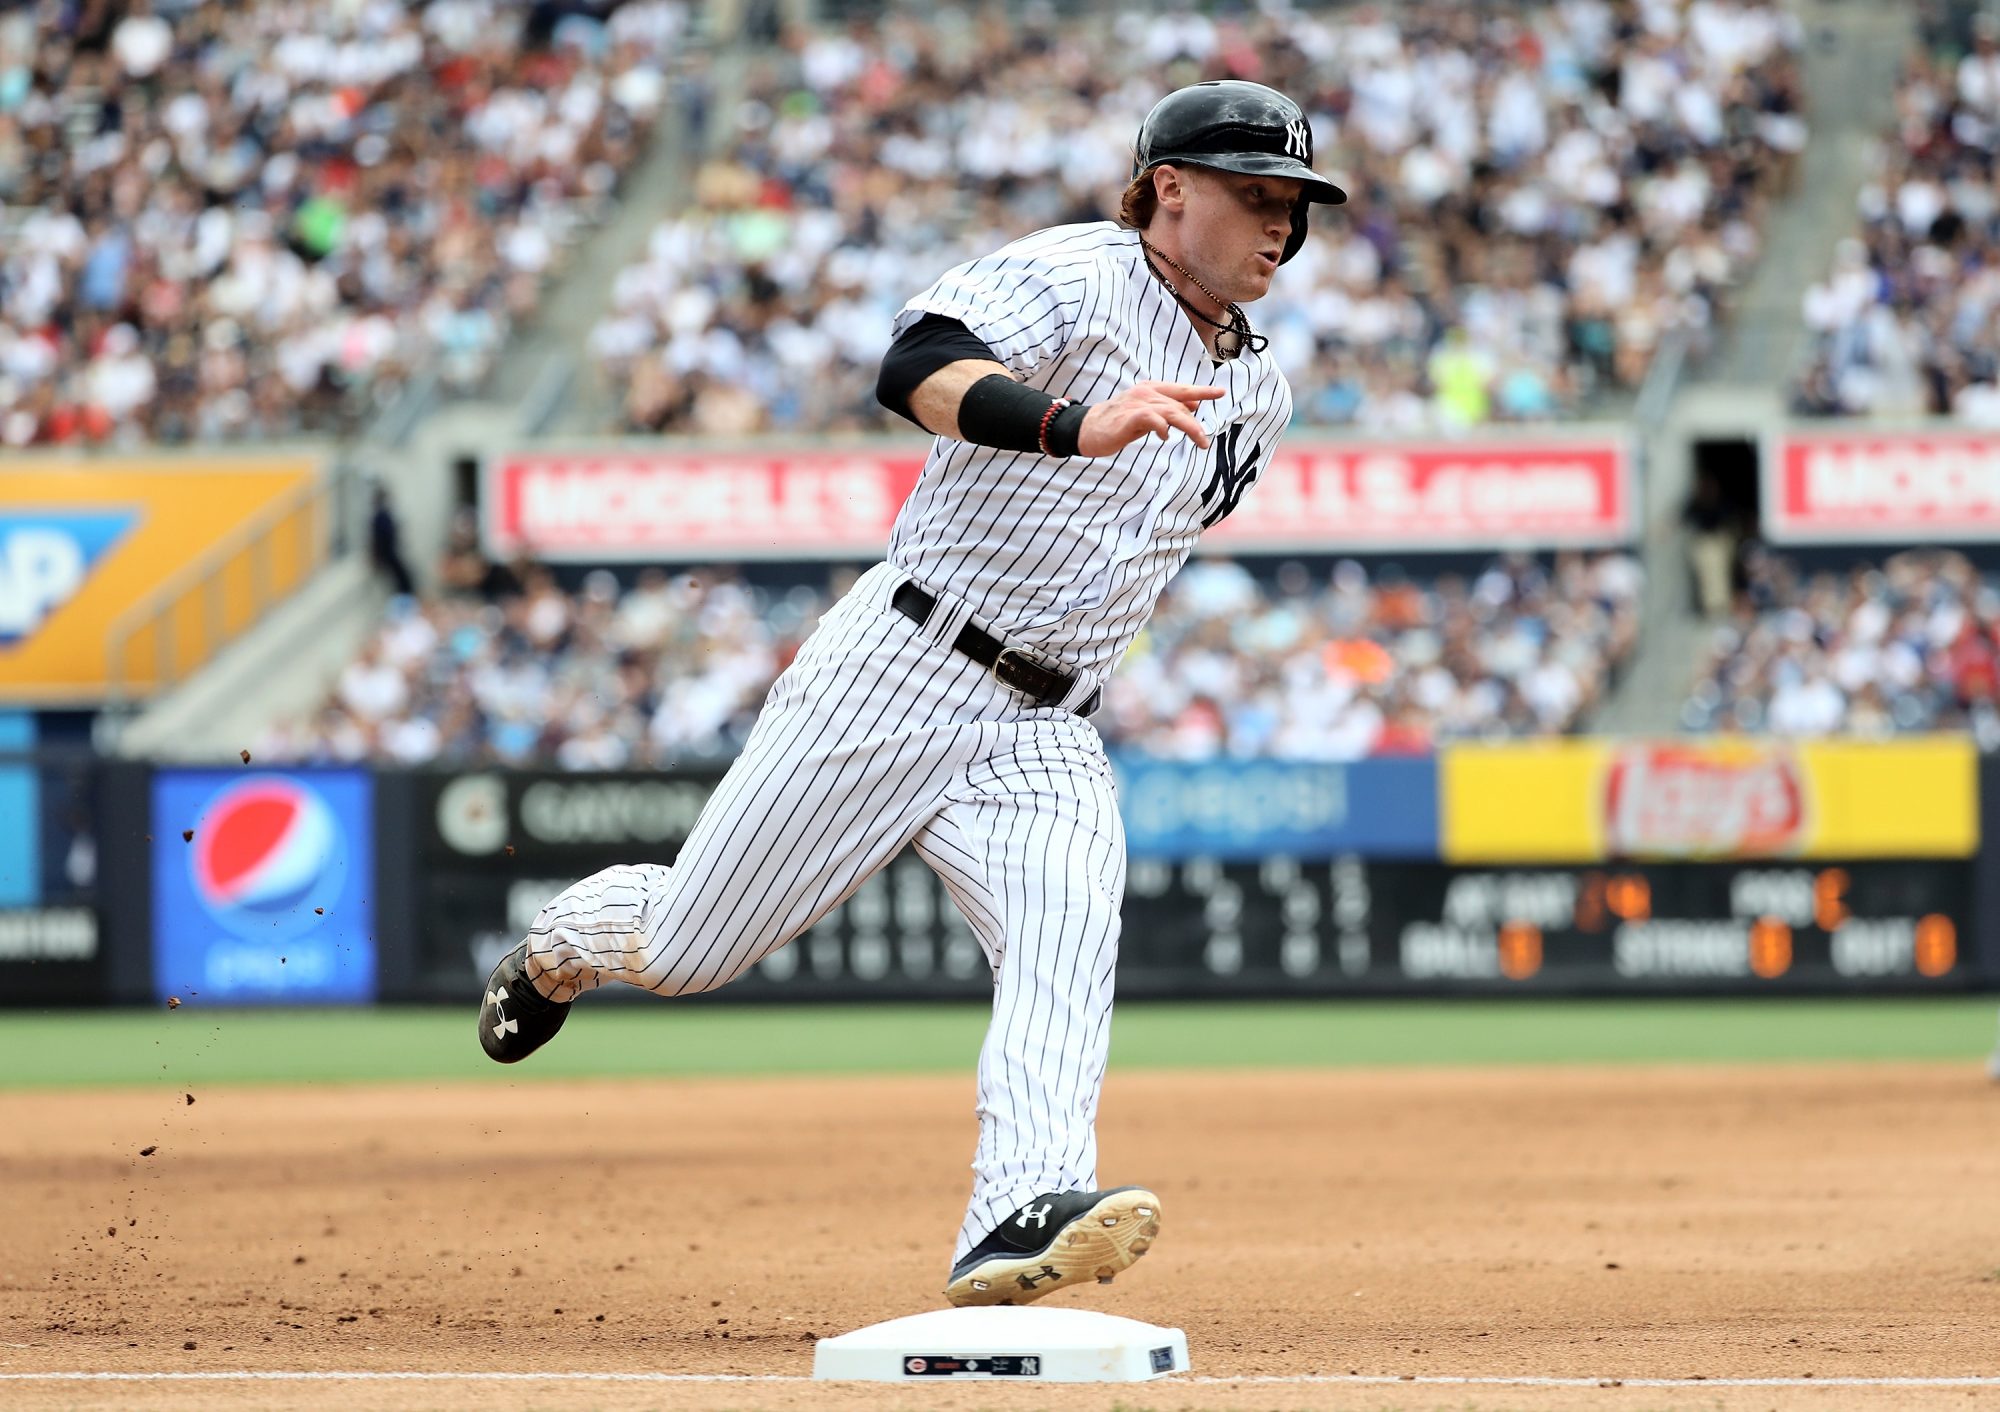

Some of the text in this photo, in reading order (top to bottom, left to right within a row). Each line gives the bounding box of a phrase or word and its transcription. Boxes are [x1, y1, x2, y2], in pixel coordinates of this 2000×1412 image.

[1284, 118, 1308, 160] NY
[522, 456, 890, 531] MODELL'S
[1200, 422, 1261, 530] NY
[1133, 764, 1346, 845] pepsi
